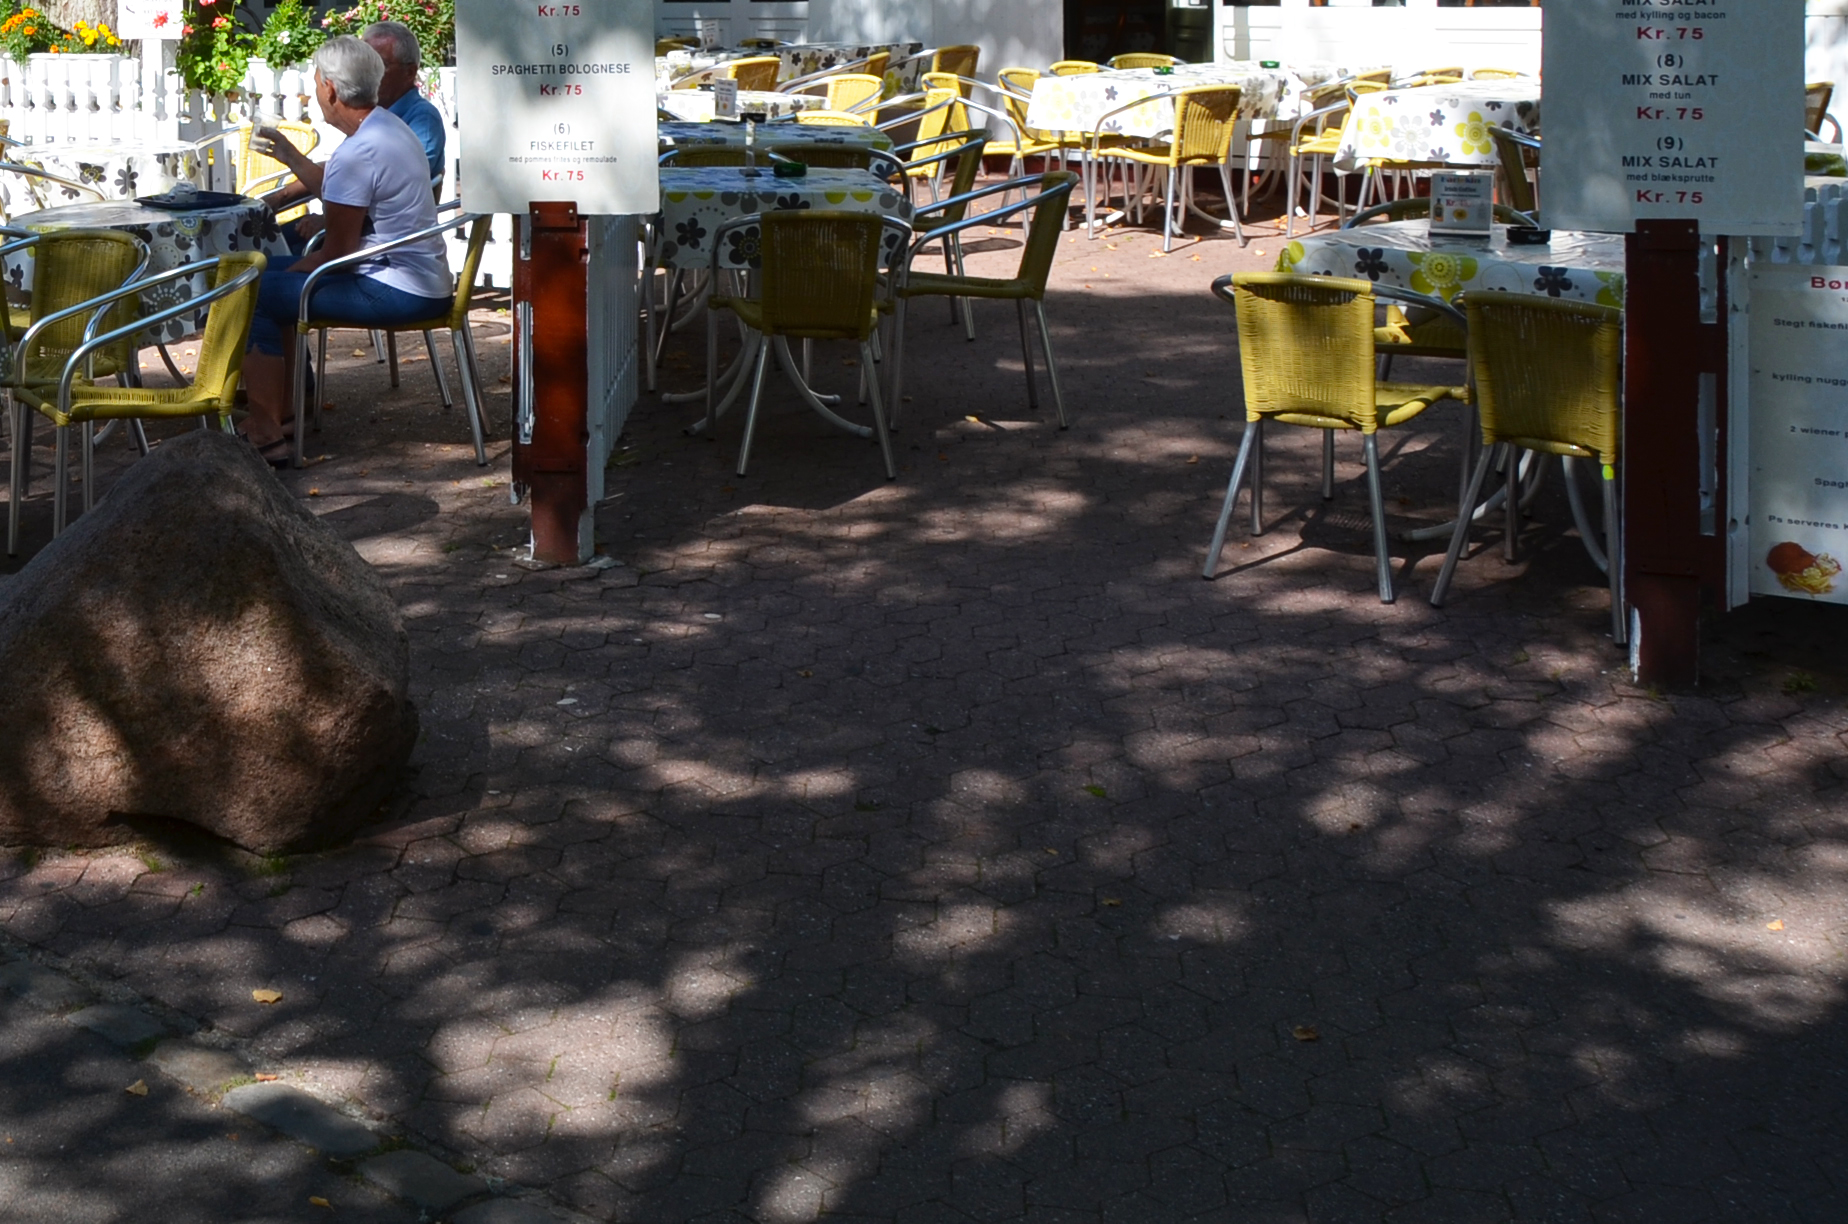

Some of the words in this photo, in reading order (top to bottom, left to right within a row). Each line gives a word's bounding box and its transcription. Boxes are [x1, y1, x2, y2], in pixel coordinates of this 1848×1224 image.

[1616, 11, 1637, 19] med
[1640, 10, 1674, 21] kylling
[1678, 11, 1691, 21] og
[1694, 11, 1726, 19] bacon
[551, 44, 569, 57] (5)
[1656, 54, 1684, 68] (8)
[492, 64, 556, 75] SPAGHETTI
[559, 63, 631, 74] BOLOGNESE
[1622, 74, 1653, 86] MIX
[1659, 74, 1719, 86] SALAT
[1649, 91, 1670, 99] med
[1674, 91, 1691, 99] tun
[553, 123, 571, 135] (6)
[530, 141, 594, 151] FISKEFILET
[1656, 136, 1684, 151] (9)
[1622, 156, 1653, 168] MIX
[1659, 156, 1719, 168] SALAT
[1627, 174, 1647, 182] med
[1651, 173, 1715, 183] blæksprutte
